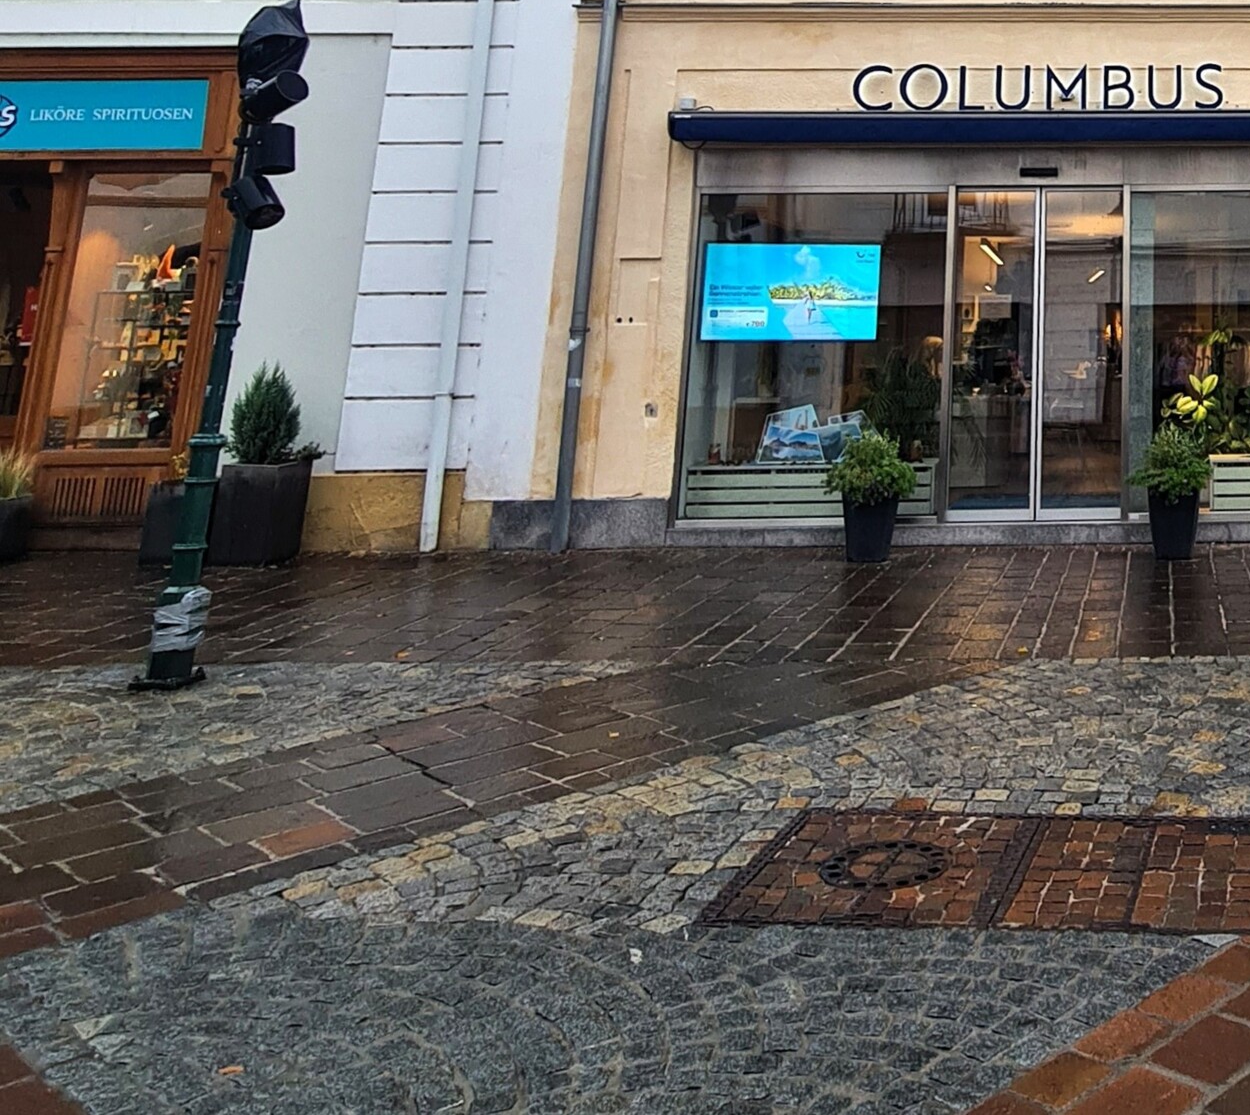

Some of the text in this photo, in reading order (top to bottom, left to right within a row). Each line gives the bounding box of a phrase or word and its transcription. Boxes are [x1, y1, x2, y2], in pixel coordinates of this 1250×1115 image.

[852, 63, 1224, 112] COLUMBUS
[30, 105, 194, 121] LIKÖRE SPIRITUOSEN
